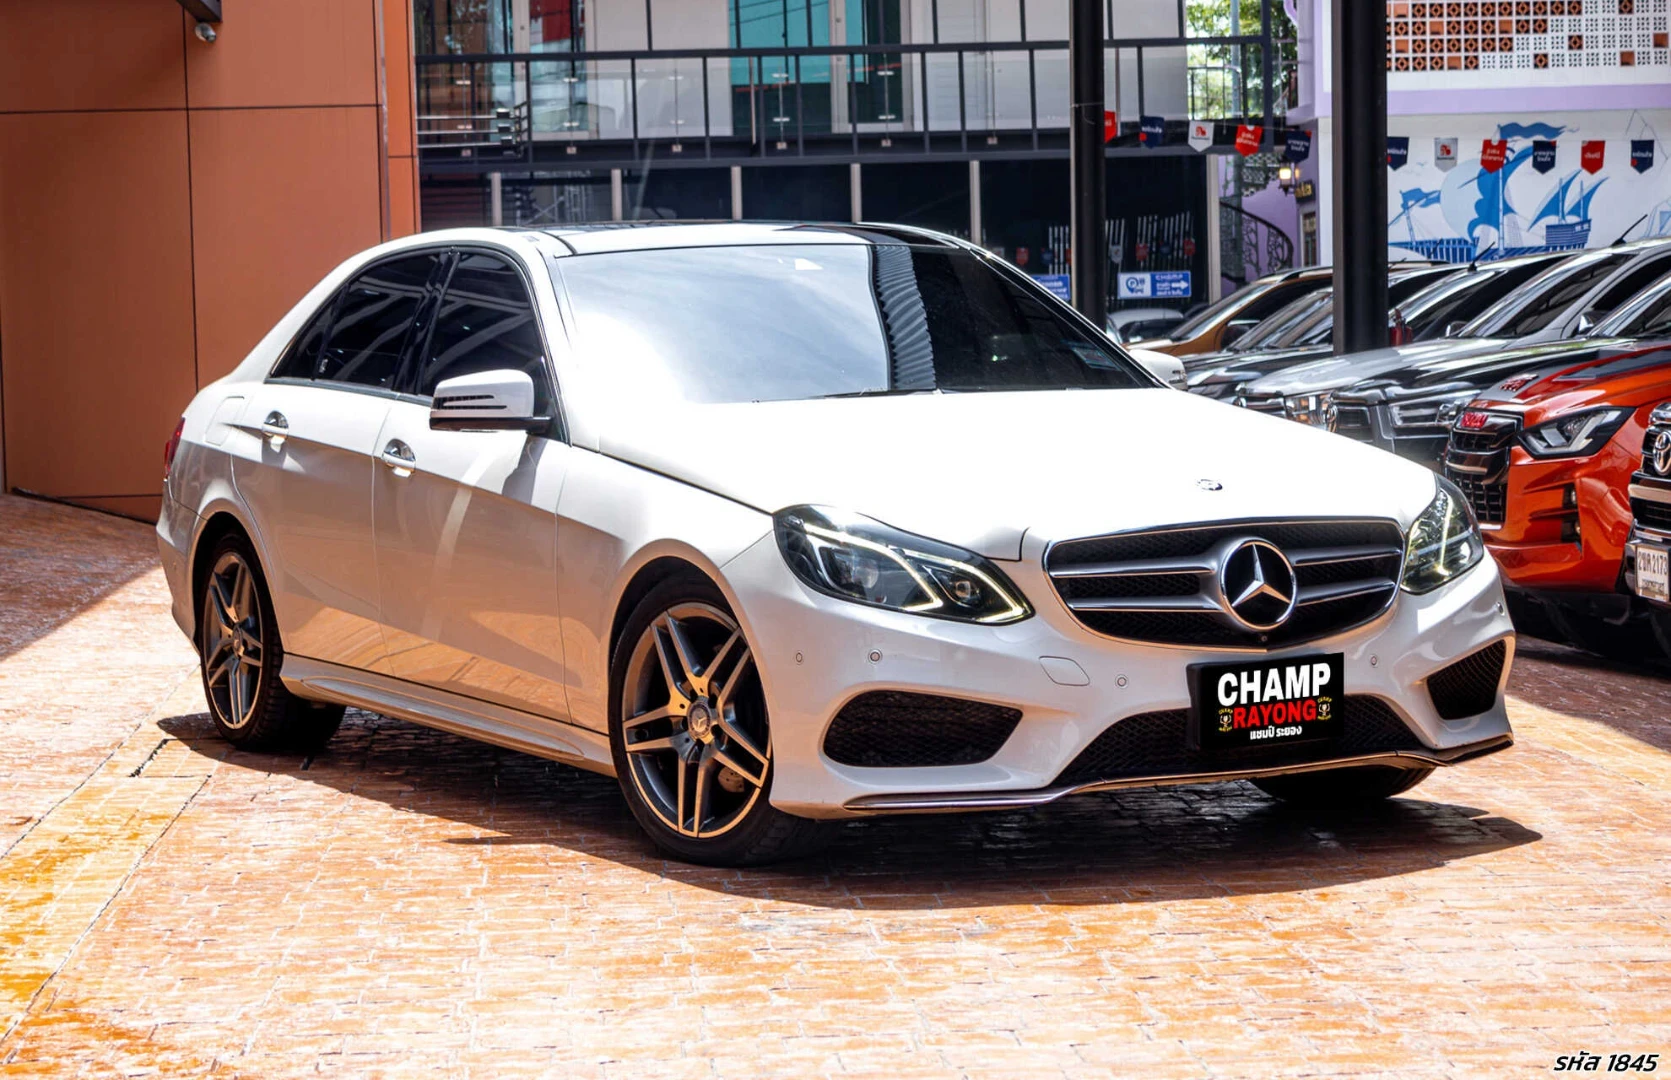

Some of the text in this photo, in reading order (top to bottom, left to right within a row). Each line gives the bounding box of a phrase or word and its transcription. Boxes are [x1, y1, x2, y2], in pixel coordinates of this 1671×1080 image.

[1217, 662, 1331, 707] CHAMP
[1233, 699, 1318, 729] RAYONG
[1276, 725, 1303, 738] ระยอง
